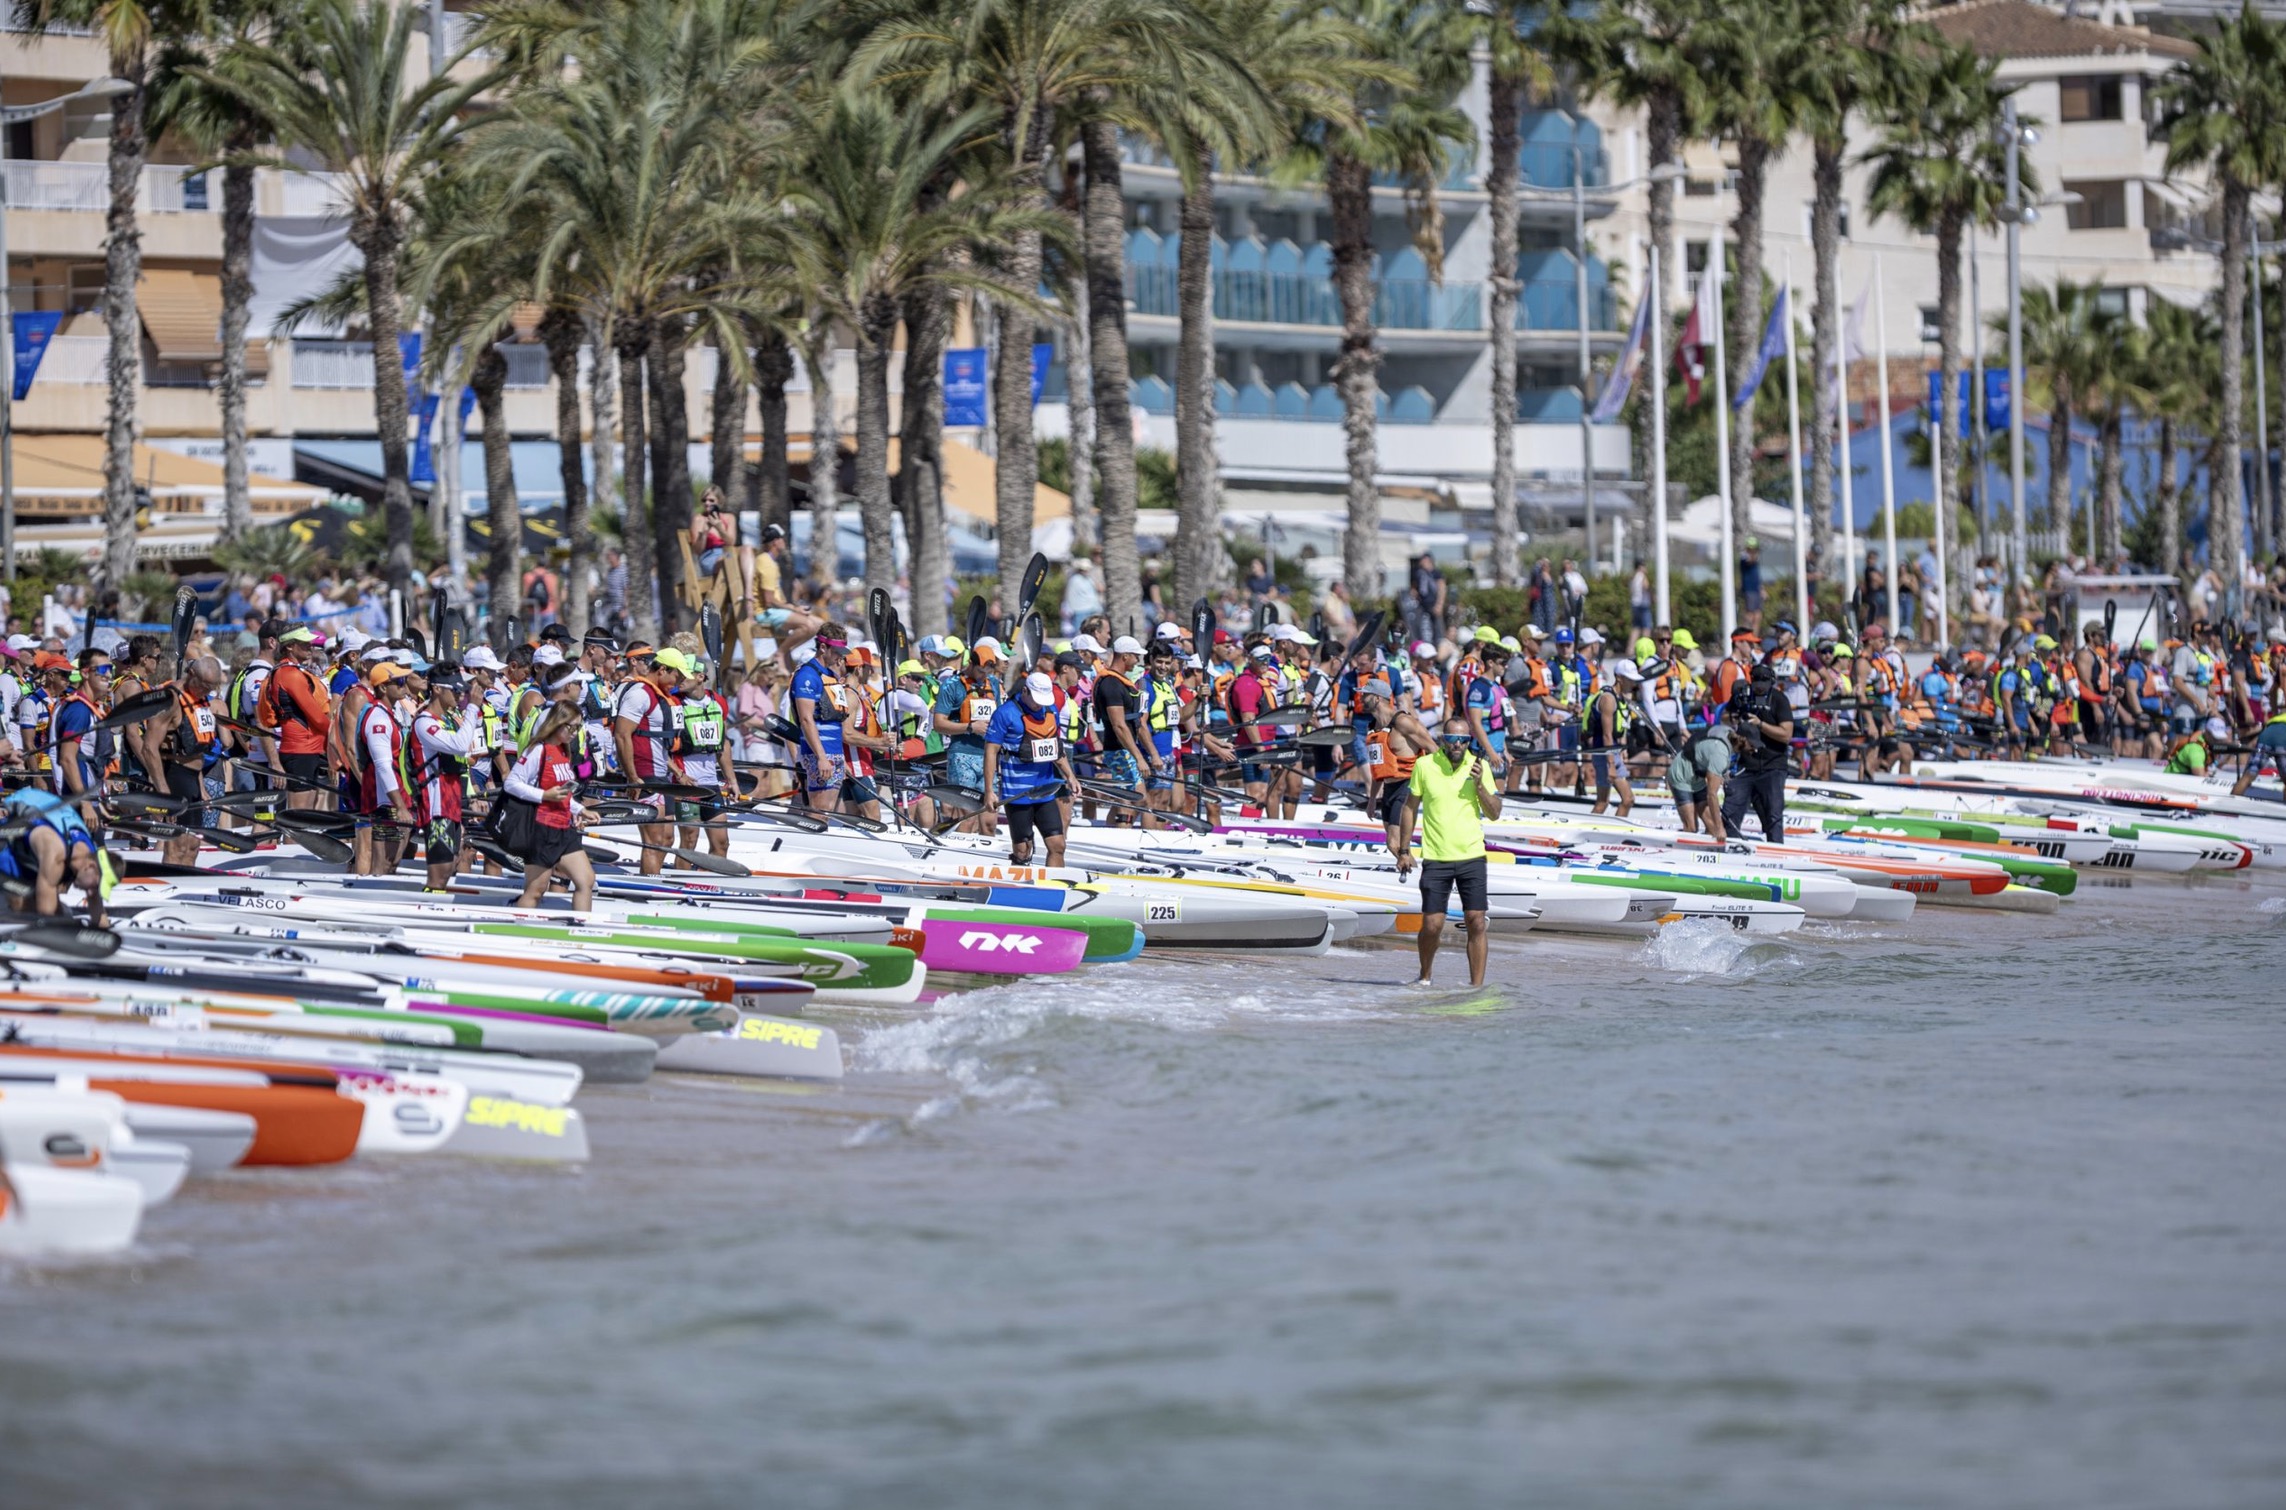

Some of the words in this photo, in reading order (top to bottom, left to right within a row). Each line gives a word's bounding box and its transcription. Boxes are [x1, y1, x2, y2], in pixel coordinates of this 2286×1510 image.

[978, 706, 992, 716] 321
[700, 728, 715, 739] 087
[1038, 745, 1054, 758] 082
[219, 896, 286, 910] VELASCO
[1150, 906, 1175, 920] 225
[740, 1018, 822, 1049] SIPRE
